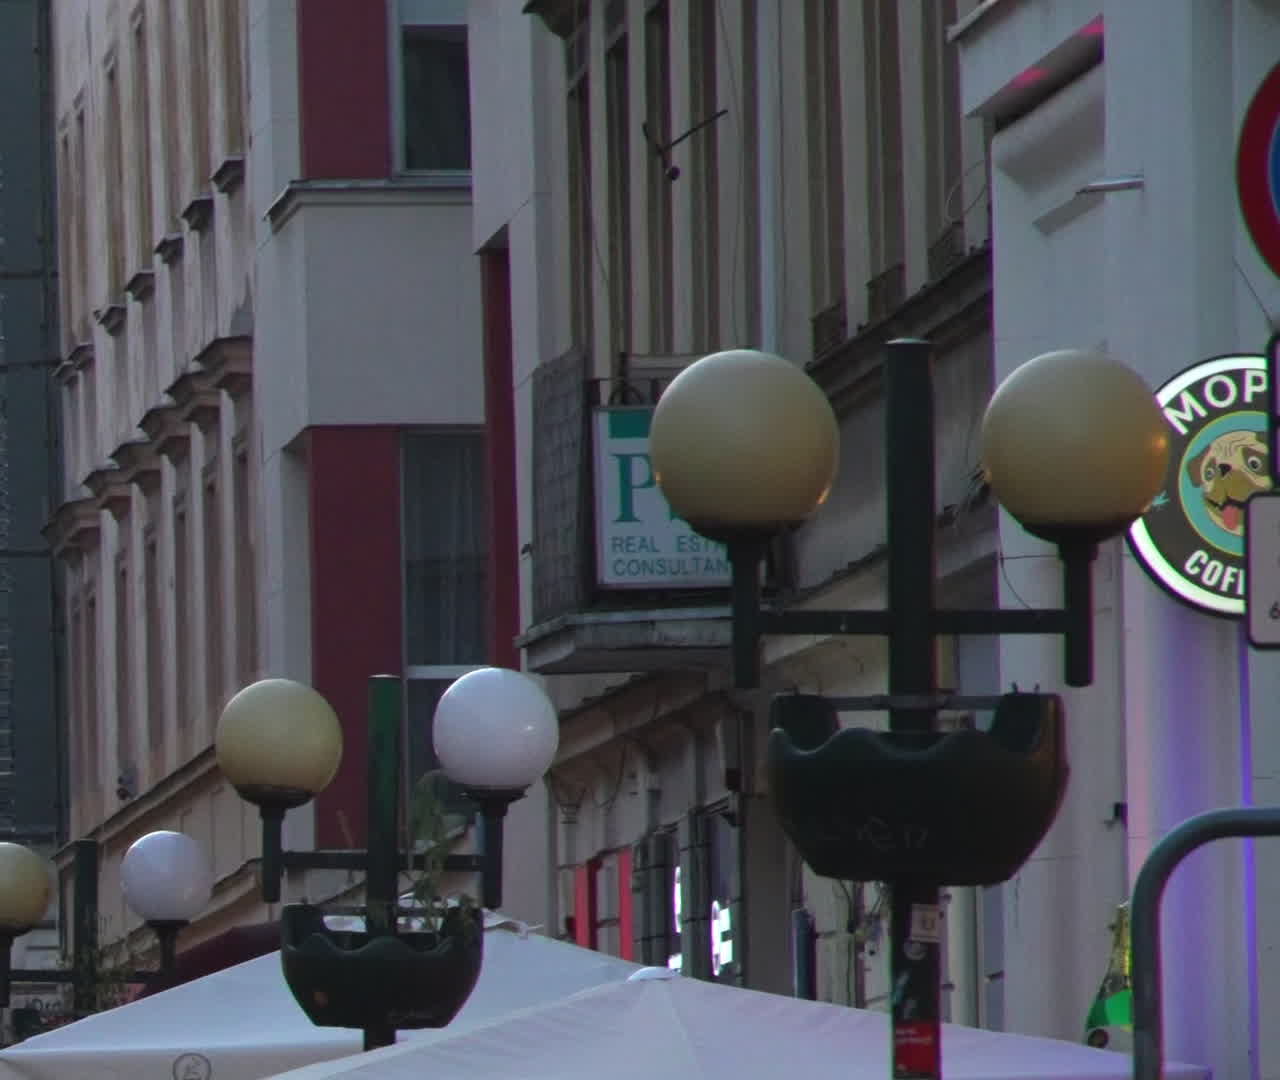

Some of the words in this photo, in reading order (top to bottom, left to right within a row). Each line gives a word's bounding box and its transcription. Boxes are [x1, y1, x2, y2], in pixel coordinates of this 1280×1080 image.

[1162, 368, 1268, 436] MOP
[612, 536, 660, 553] REAL
[612, 558, 730, 577] CONSULTAN
[1184, 549, 1244, 596] COF
